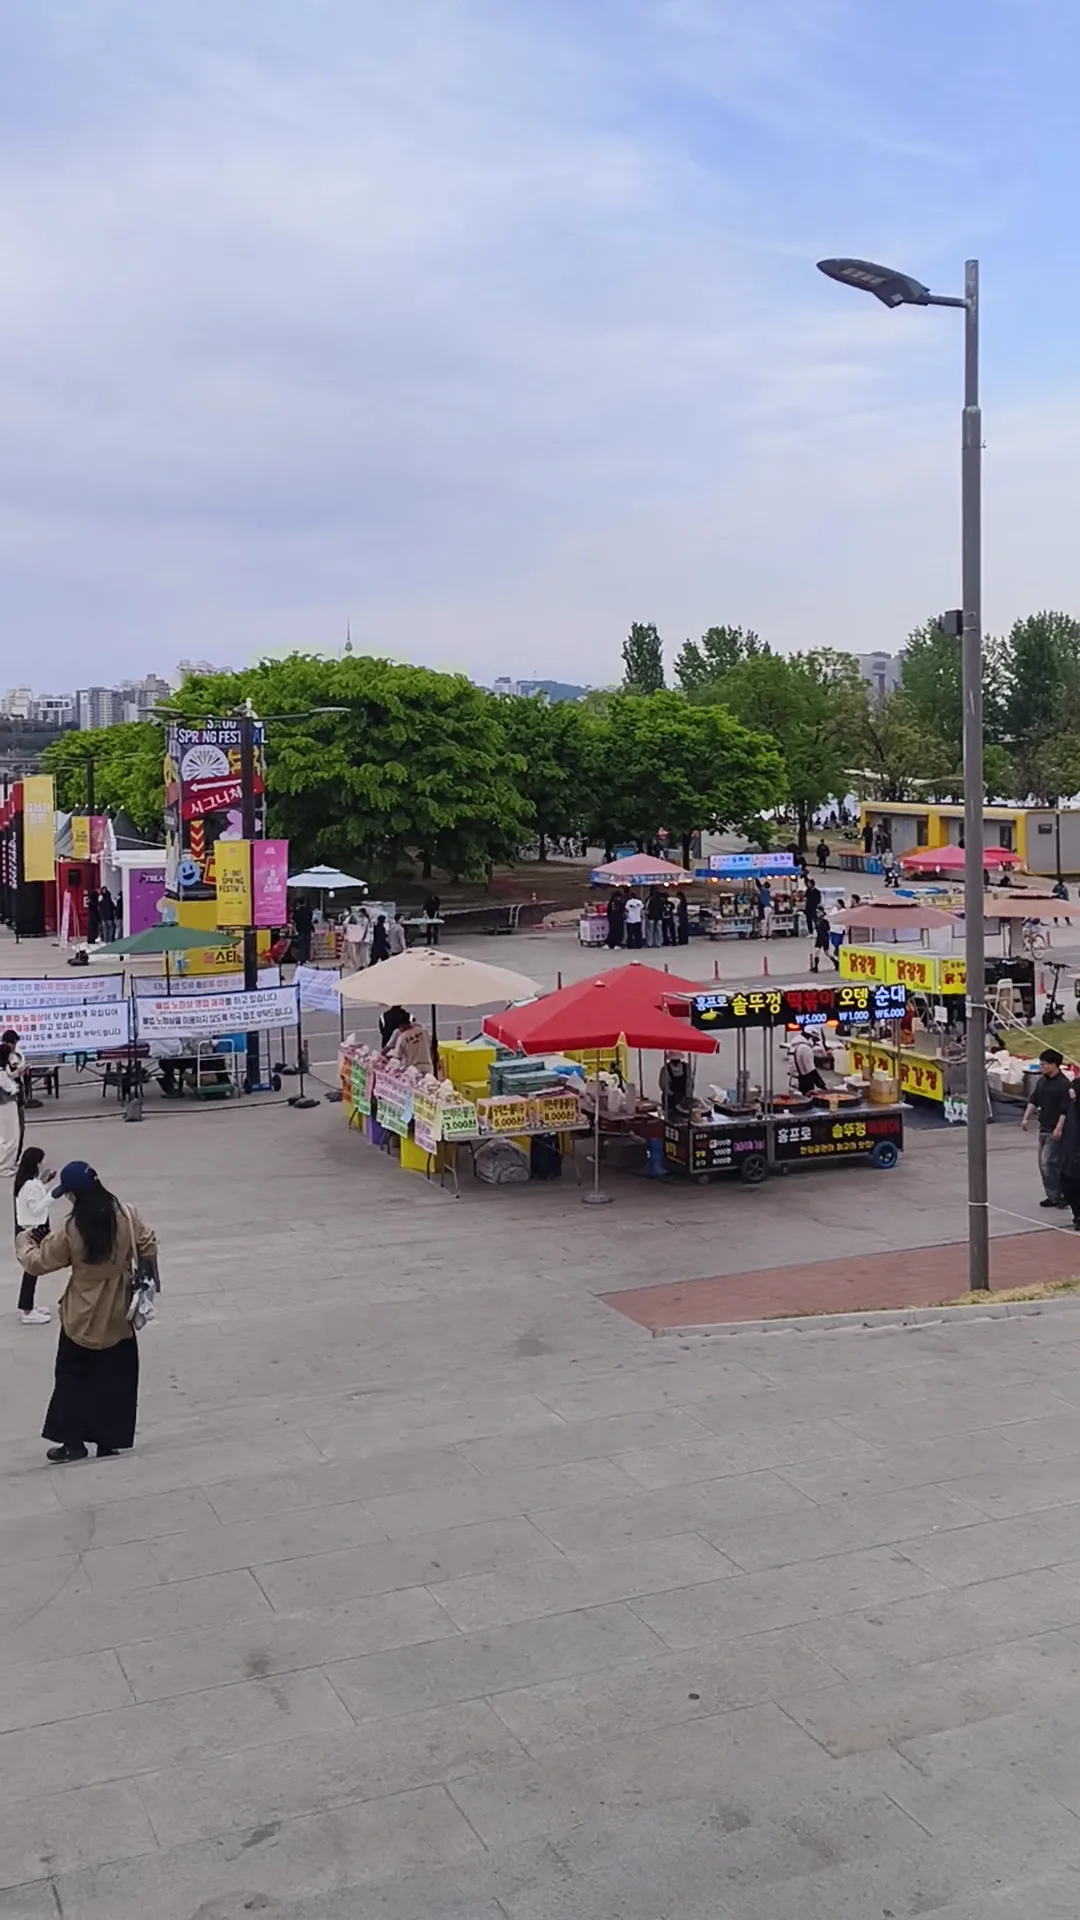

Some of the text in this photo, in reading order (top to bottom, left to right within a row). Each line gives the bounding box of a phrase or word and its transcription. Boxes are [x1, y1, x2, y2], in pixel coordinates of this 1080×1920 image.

[218, 728, 269, 745] FESTAL
[695, 983, 907, 1017] 홍프로 솥뚜껑 떡볶이 오뎅 순대
[777, 1126, 812, 1144] 홍프로
